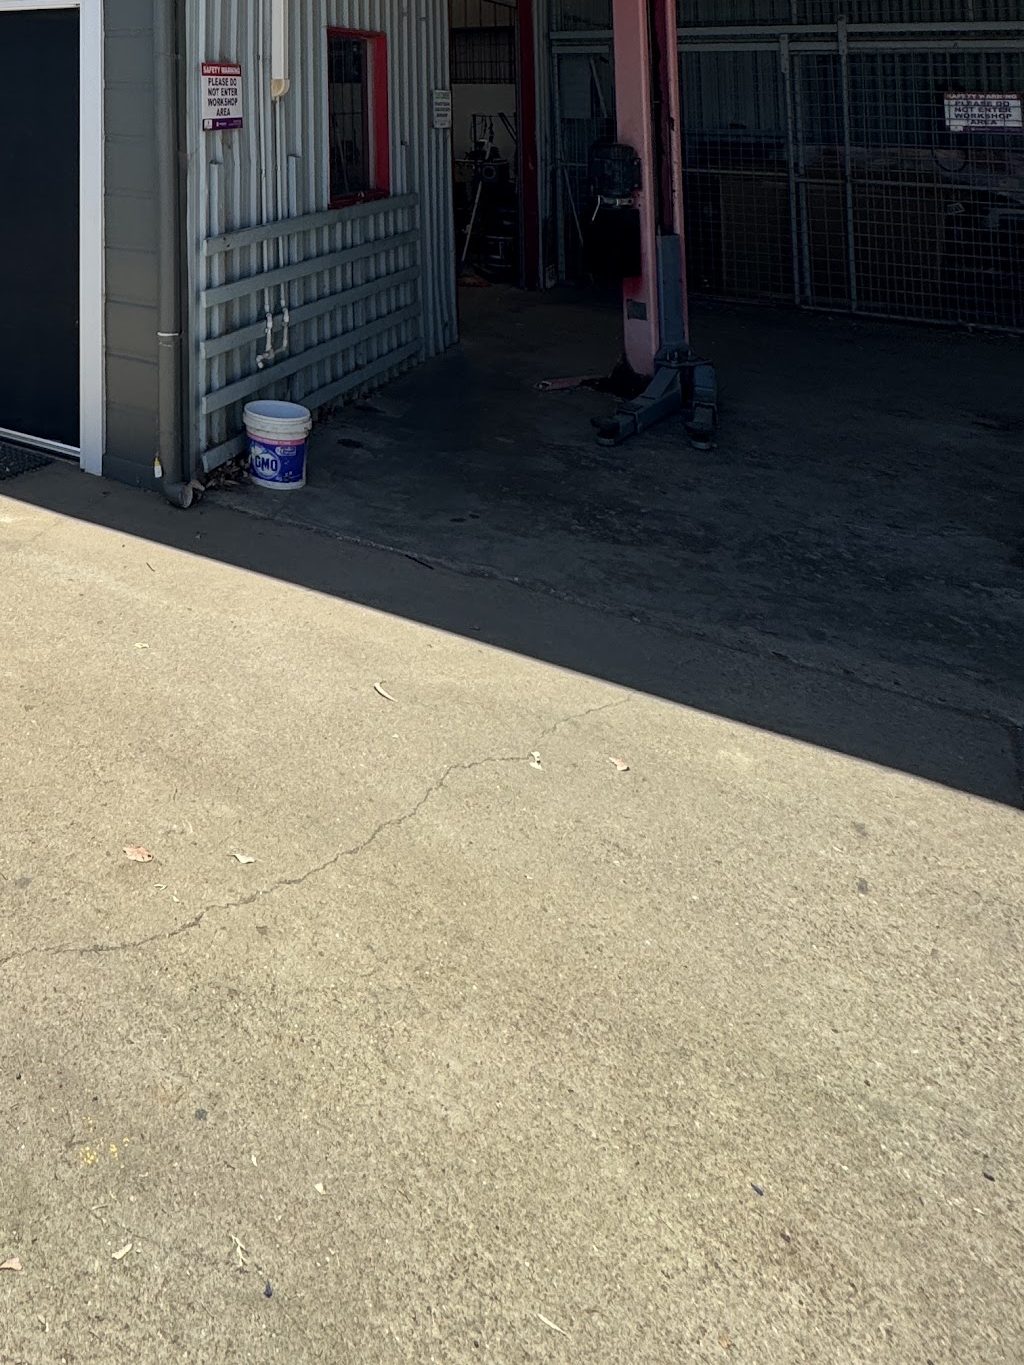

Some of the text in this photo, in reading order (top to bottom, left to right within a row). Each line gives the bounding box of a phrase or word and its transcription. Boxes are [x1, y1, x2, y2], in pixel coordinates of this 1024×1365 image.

[203, 66, 220, 74] SAFETY
[208, 78, 237, 86] PLEASE DO
[208, 88, 237, 96] NOT ENTER
[208, 98, 238, 106] WORKSHOP
[216, 108, 230, 116] AREA
